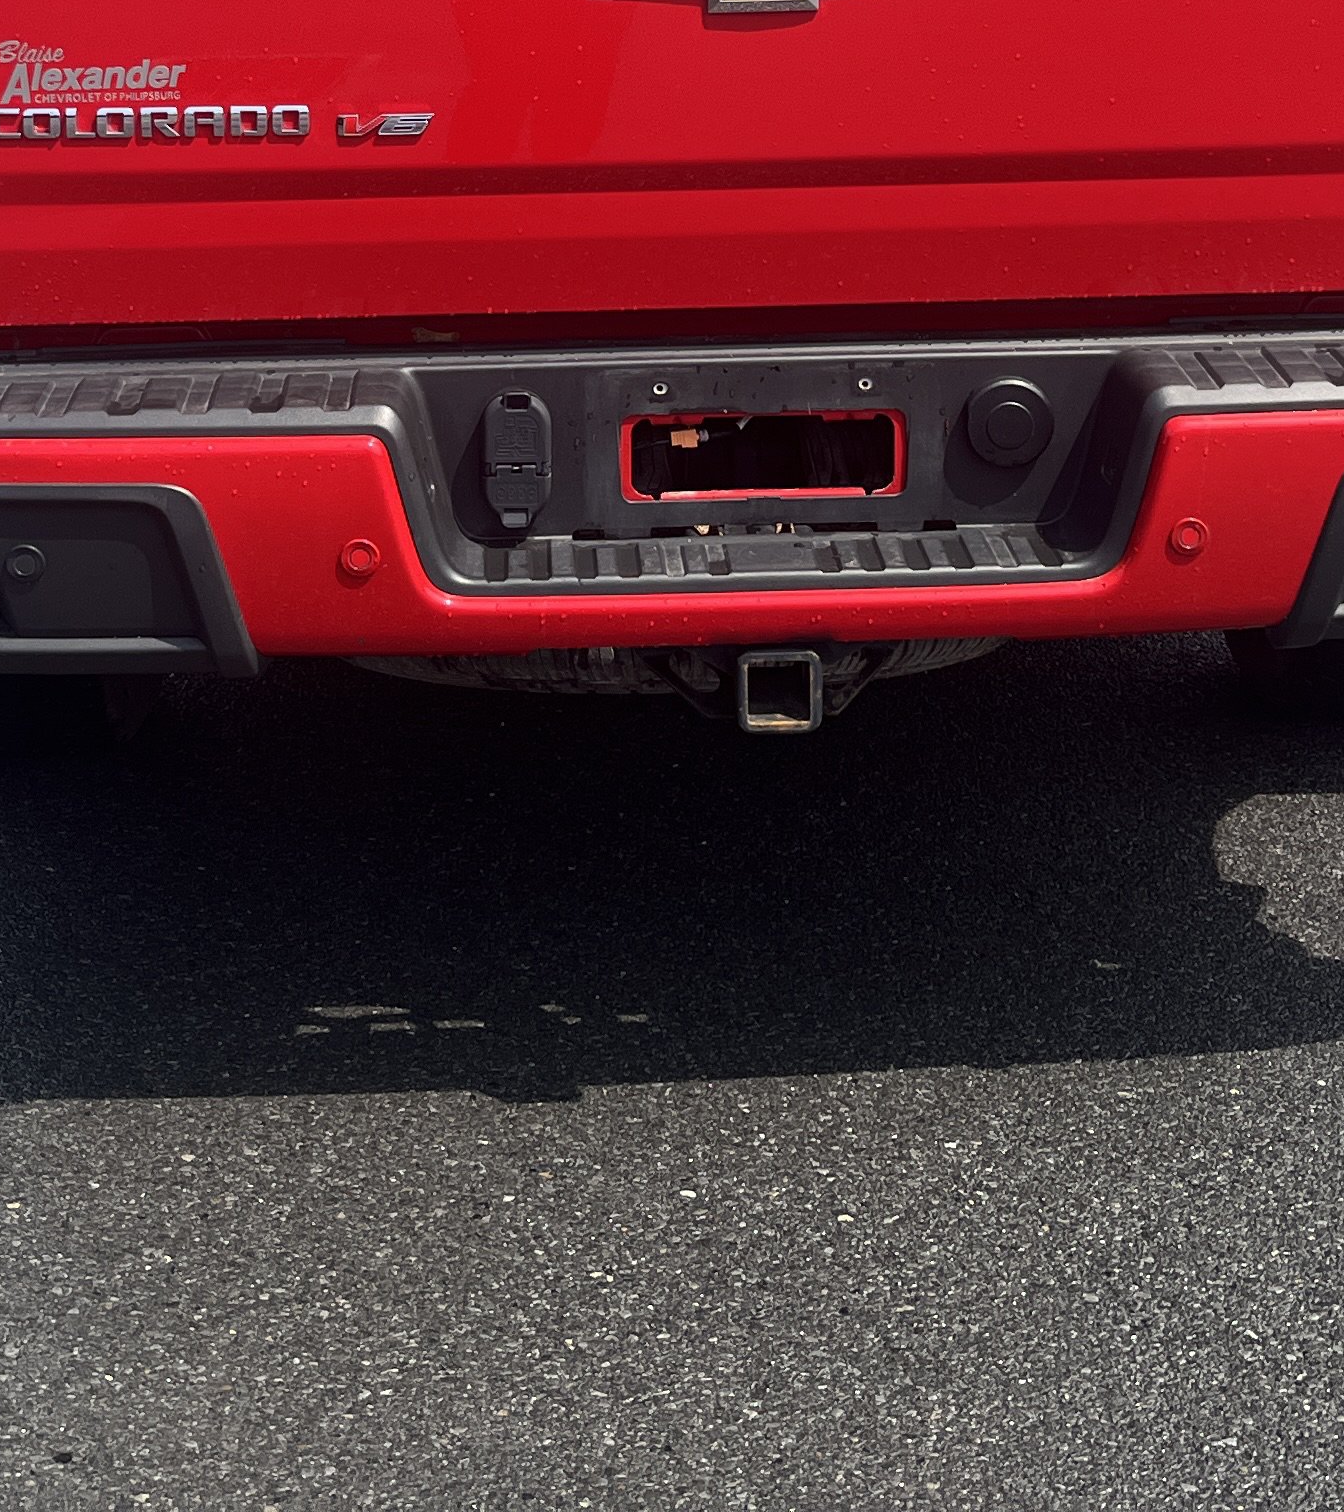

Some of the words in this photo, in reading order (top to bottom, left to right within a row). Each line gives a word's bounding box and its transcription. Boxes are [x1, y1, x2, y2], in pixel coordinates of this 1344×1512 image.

[0, 58, 187, 105] Alexander
[34, 92, 101, 104] CHEVROLET
[104, 92, 117, 102] OF
[119, 90, 181, 102] PHILIPSBURG
[337, 112, 435, 137] V6
